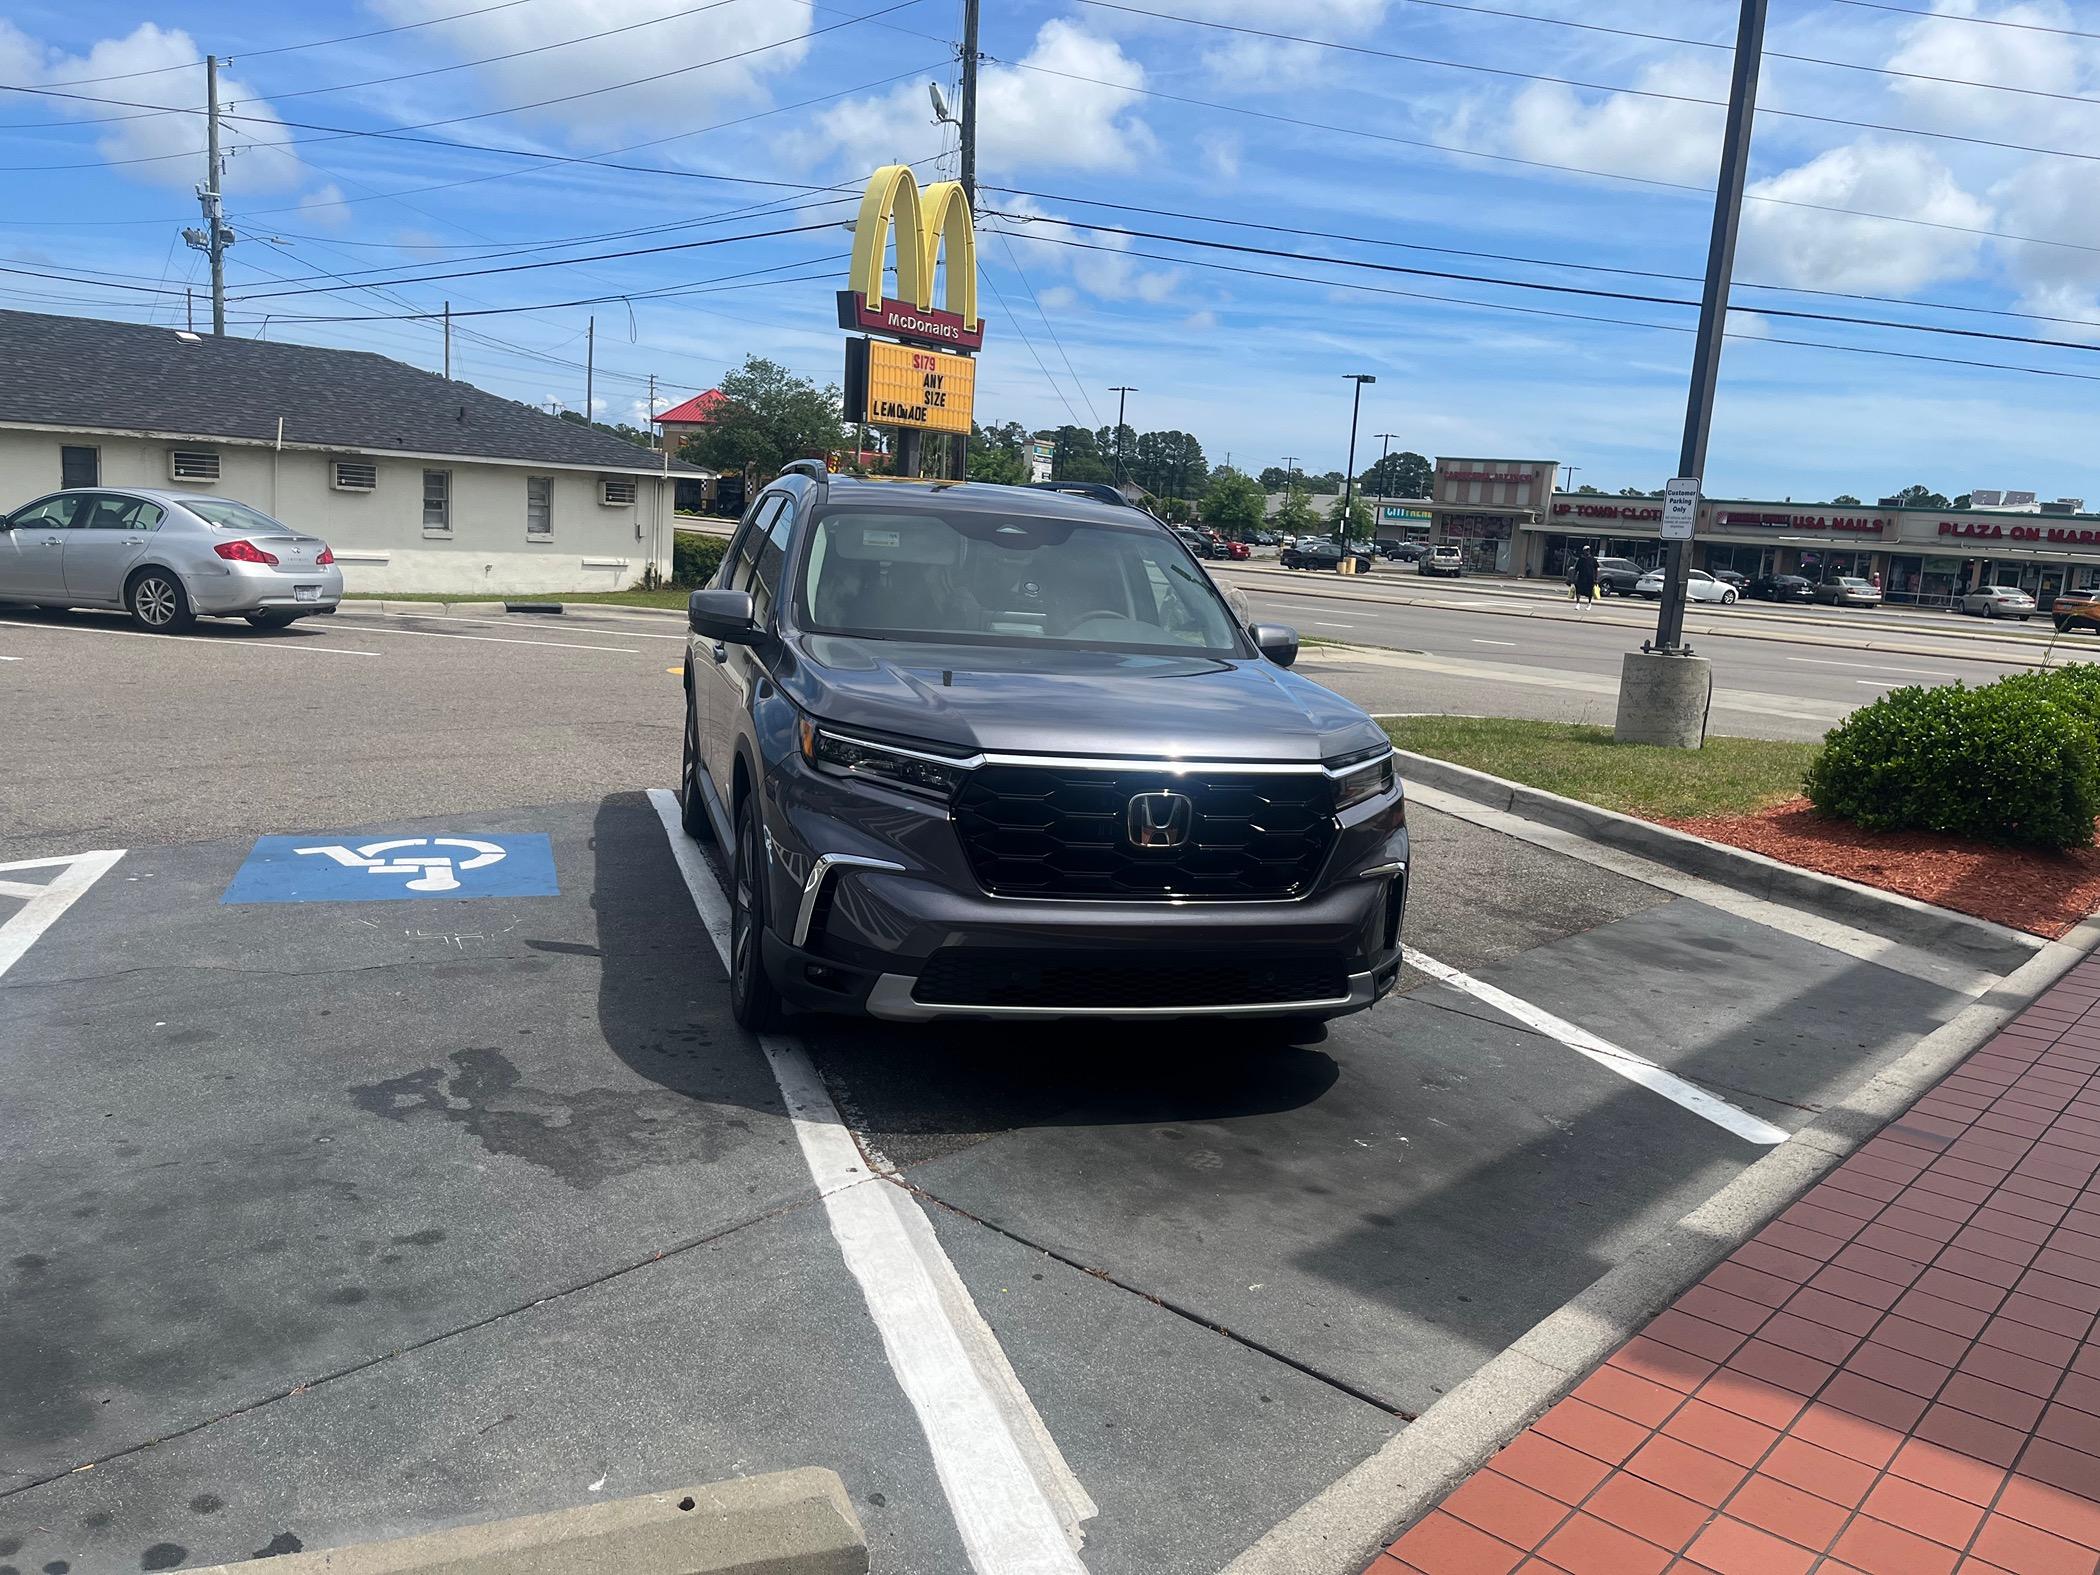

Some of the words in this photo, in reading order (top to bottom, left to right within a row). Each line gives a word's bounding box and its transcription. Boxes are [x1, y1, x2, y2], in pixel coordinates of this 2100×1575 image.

[888, 313, 959, 339] McDonald's
[923, 373, 944, 390] ANY
[924, 390, 946, 407] SIZE
[873, 400, 927, 422] LEMONADE
[1669, 497, 1692, 506] Parking
[1553, 503, 1571, 516] UP
[1575, 504, 1618, 519] TOWN
[1792, 514, 1826, 529] USA
[1831, 517, 1884, 533] NAILS
[1938, 521, 2002, 539] PLAZA
[2010, 526, 2041, 542] ON
